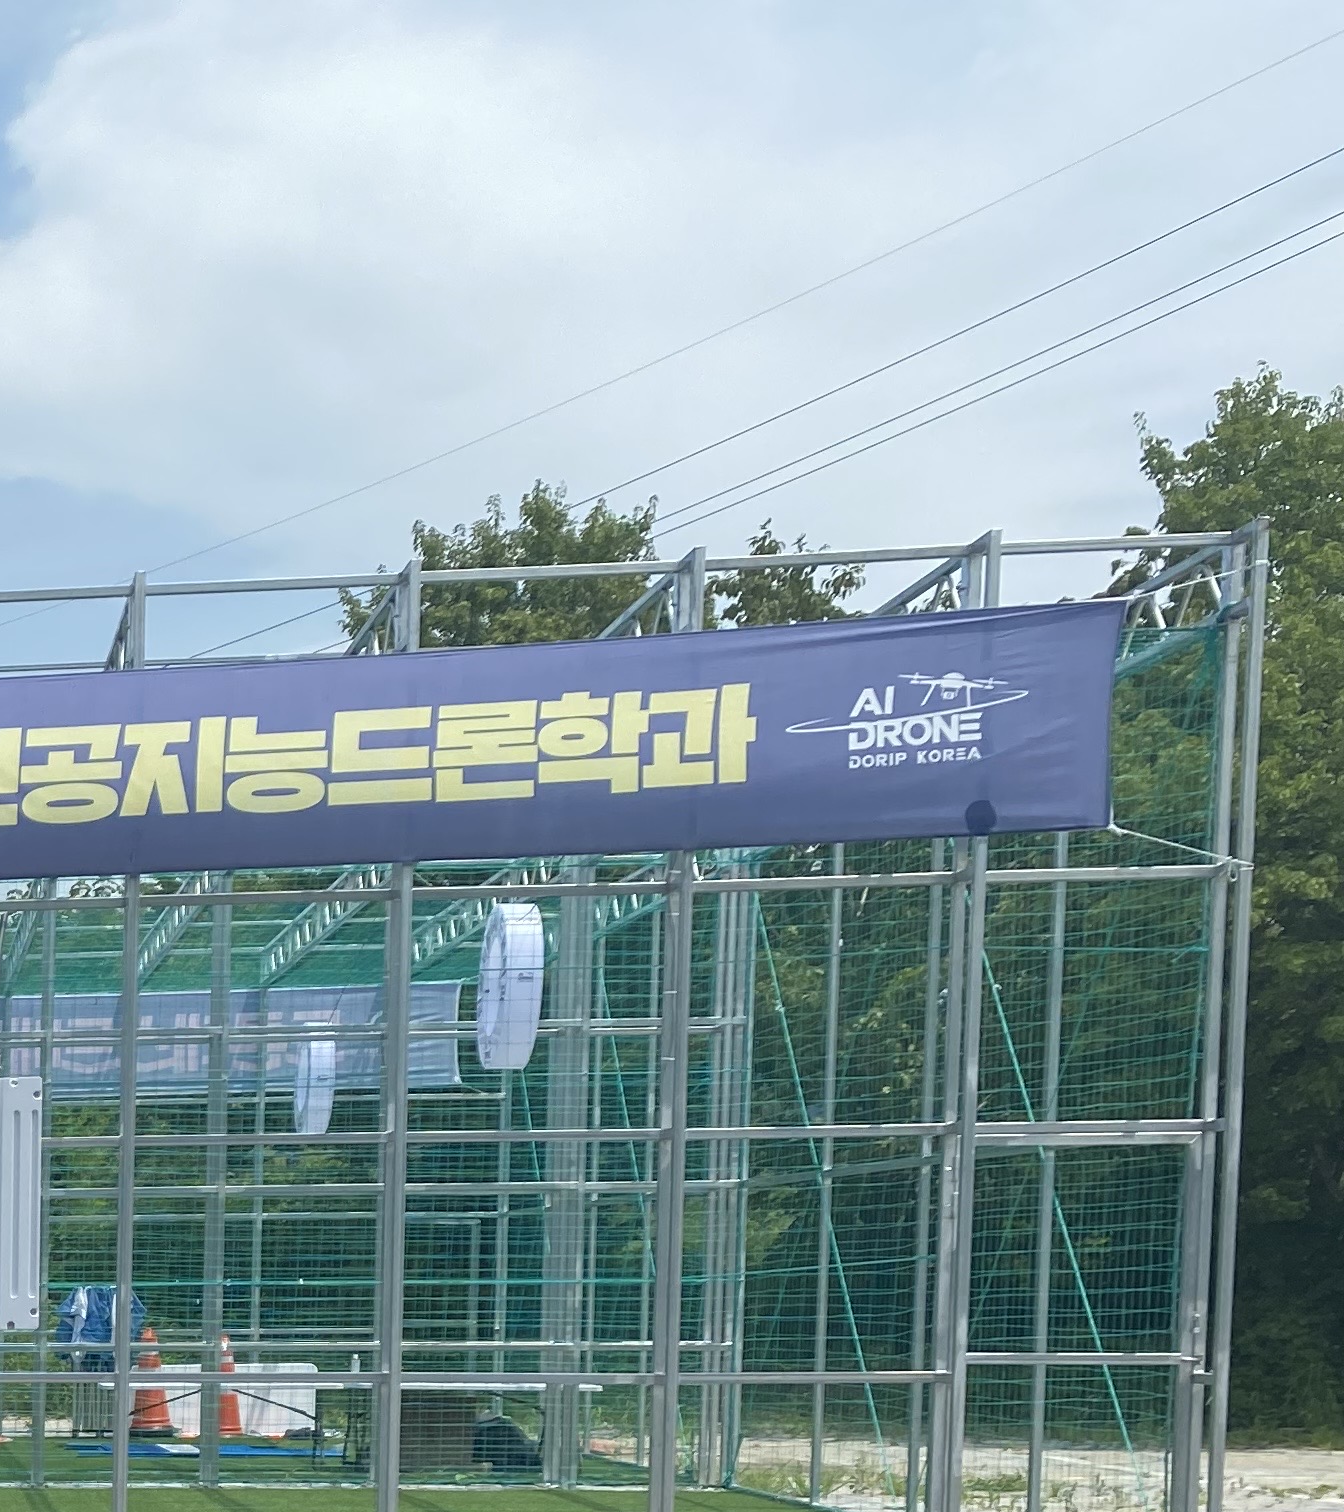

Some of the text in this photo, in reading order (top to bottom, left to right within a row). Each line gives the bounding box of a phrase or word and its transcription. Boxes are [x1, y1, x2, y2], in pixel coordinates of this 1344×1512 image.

[849, 685, 896, 718] AI
[848, 711, 983, 751] DRONE
[848, 746, 983, 769] DORIP KOREA
